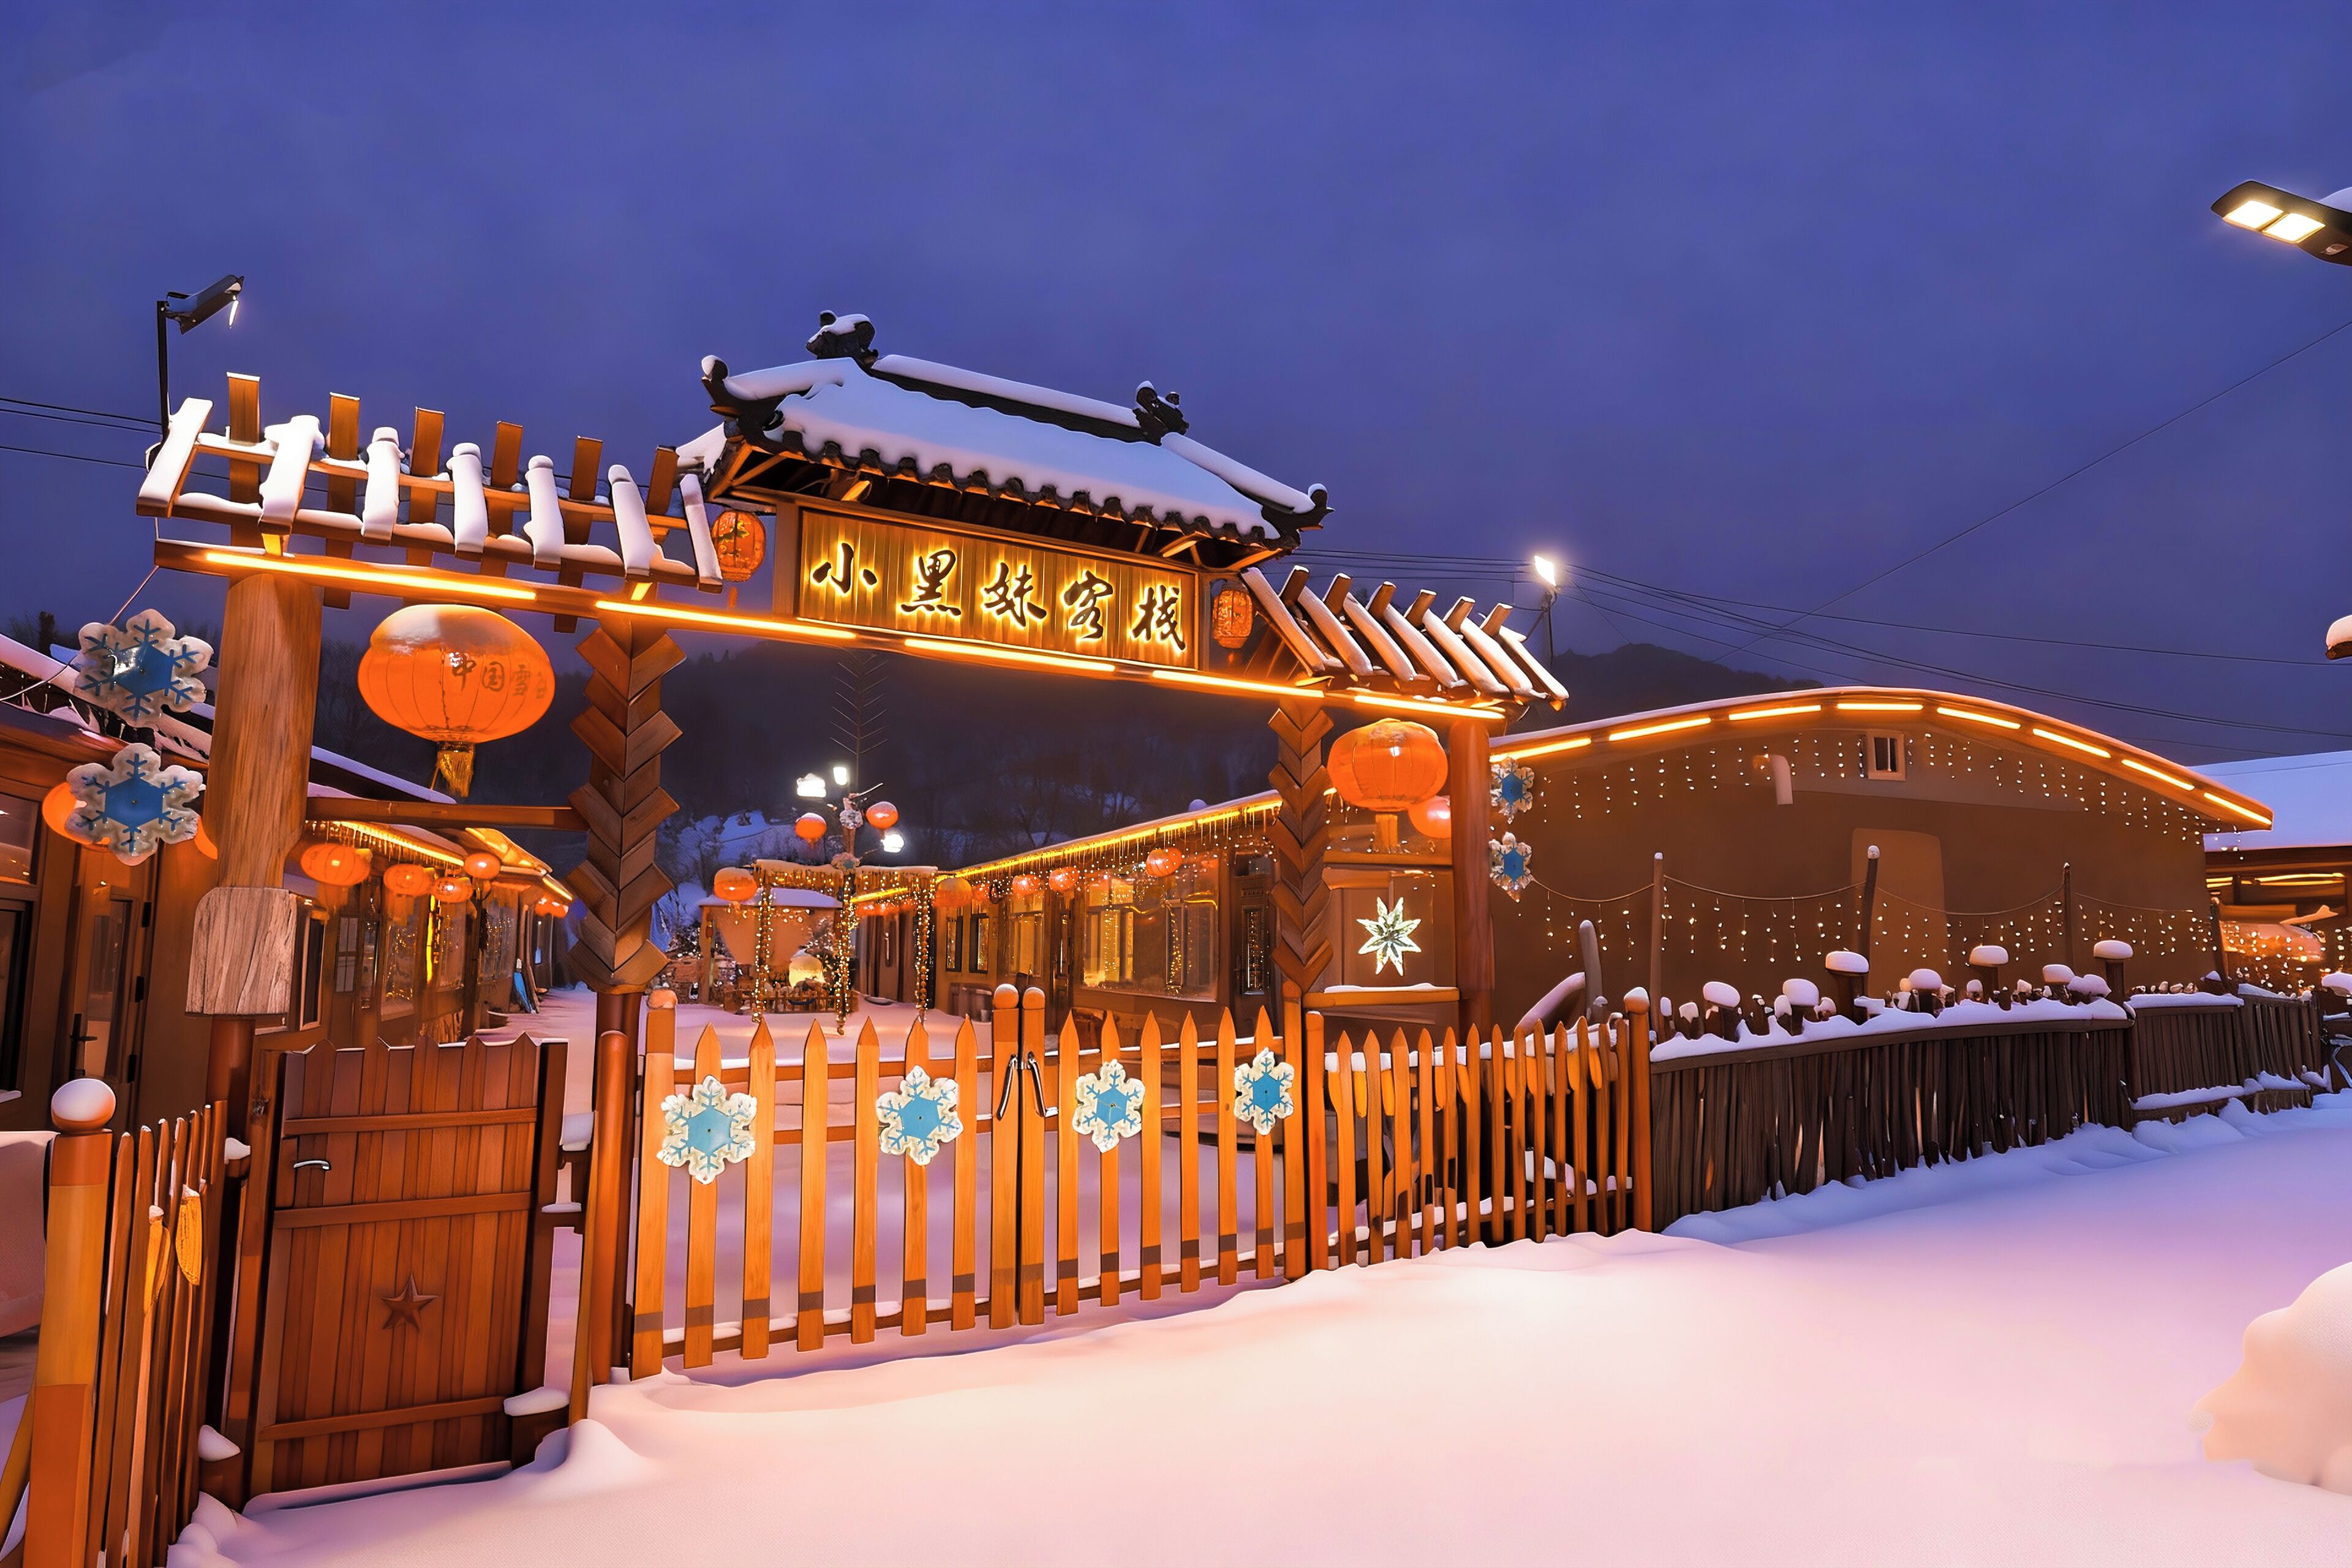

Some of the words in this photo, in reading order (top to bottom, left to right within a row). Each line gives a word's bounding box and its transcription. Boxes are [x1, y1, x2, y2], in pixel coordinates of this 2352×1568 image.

[812, 543, 1186, 650] 小黑妹客栈
